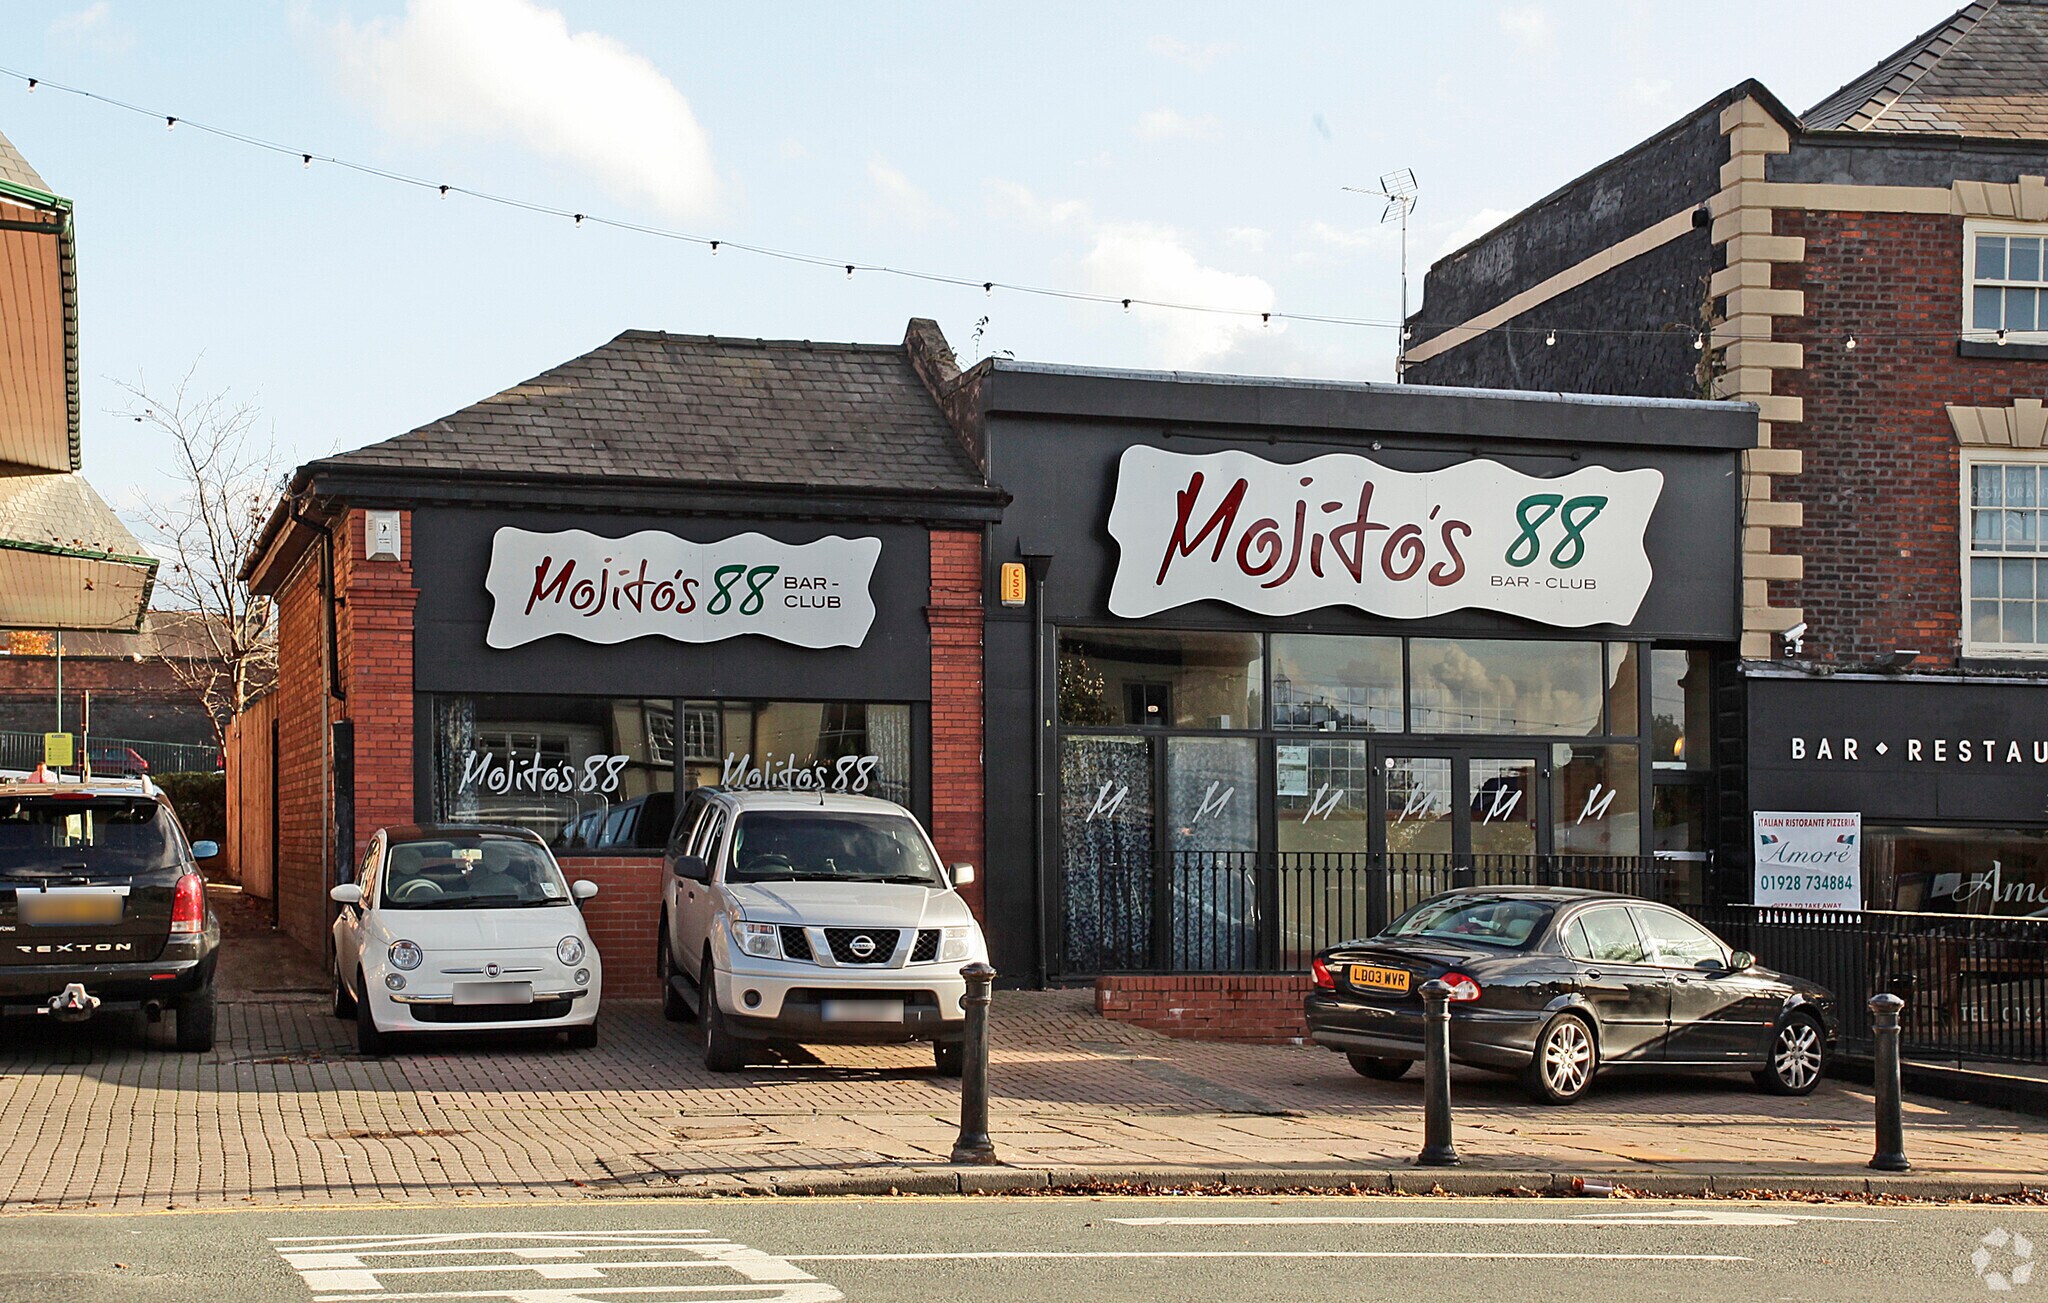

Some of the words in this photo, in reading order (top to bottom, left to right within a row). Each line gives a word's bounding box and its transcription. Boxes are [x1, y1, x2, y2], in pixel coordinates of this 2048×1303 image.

[1155, 471, 1472, 589] Mojito's
[1503, 493, 1610, 569] 88
[524, 555, 700, 617] Mojito's
[706, 564, 780, 616] 88
[1490, 575, 1532, 588] BAR
[1545, 577, 1597, 590] CLUB
[783, 595, 842, 609] CLUB
[1791, 738, 1859, 760] BAR
[1908, 739, 2048, 763] RESTAU
[458, 750, 575, 795] Mojito's
[579, 755, 630, 793] 88
[831, 755, 879, 792] 88
[1759, 818, 1784, 827] ITALIAN
[1786, 818, 1825, 827] RISTORANTE
[1826, 819, 1856, 827] PIZZERIA
[1760, 841, 1852, 863] Amoré
[1761, 875, 1801, 890] 01928
[1806, 875, 1853, 890] 734884
[16, 942, 132, 953] REXTON
